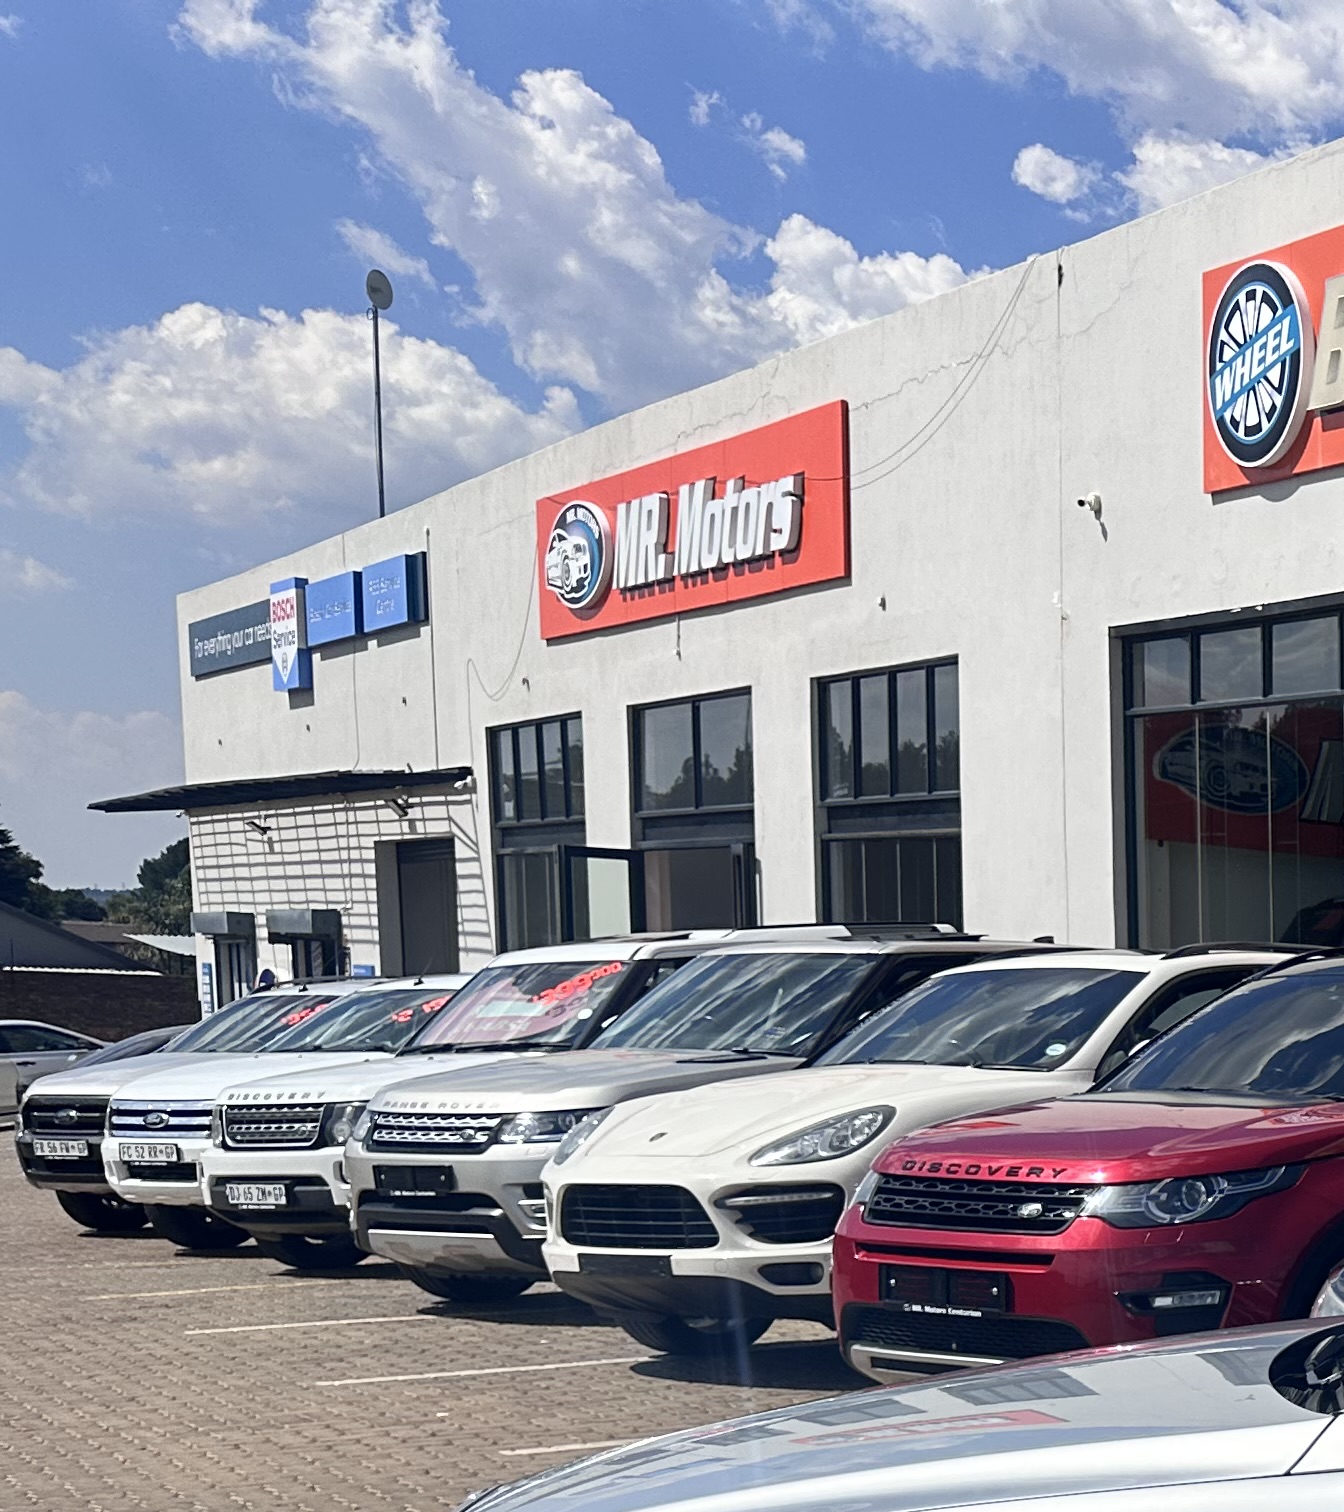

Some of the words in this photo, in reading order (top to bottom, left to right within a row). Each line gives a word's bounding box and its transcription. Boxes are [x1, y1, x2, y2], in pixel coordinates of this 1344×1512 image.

[1215, 315, 1294, 411] WHEEL
[613, 493, 671, 590] MR.
[673, 475, 800, 586] Motors
[272, 597, 295, 623] BOSCH
[273, 625, 296, 649] Service
[134, 1145, 146, 1159] 52
[902, 1160, 1068, 1179] DISCOVERY
